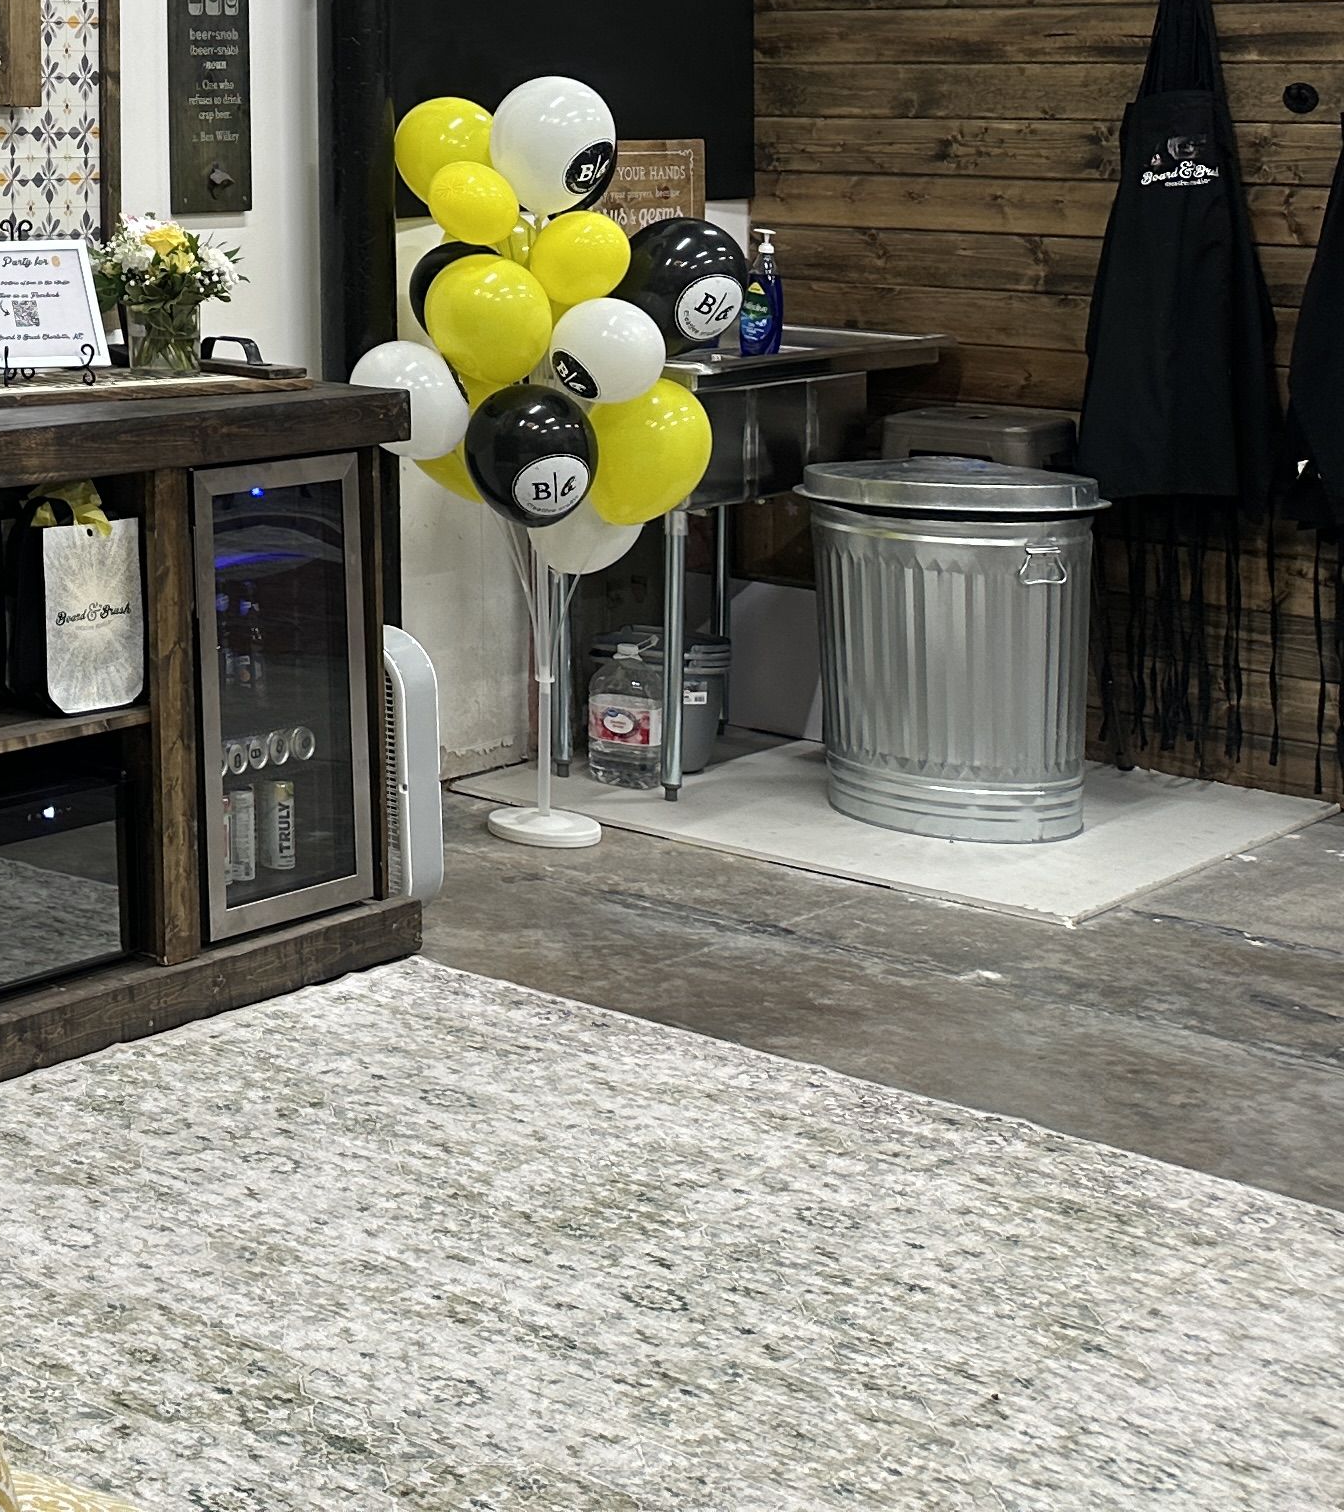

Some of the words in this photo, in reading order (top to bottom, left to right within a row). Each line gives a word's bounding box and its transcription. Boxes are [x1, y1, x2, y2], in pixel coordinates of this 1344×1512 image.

[617, 166, 646, 181] YOUR
[649, 165, 687, 181] HANDS
[1140, 167, 1179, 186] Board
[2, 256, 32, 268] Party
[99, 601, 132, 619] Brush
[278, 801, 292, 854] TRULY
